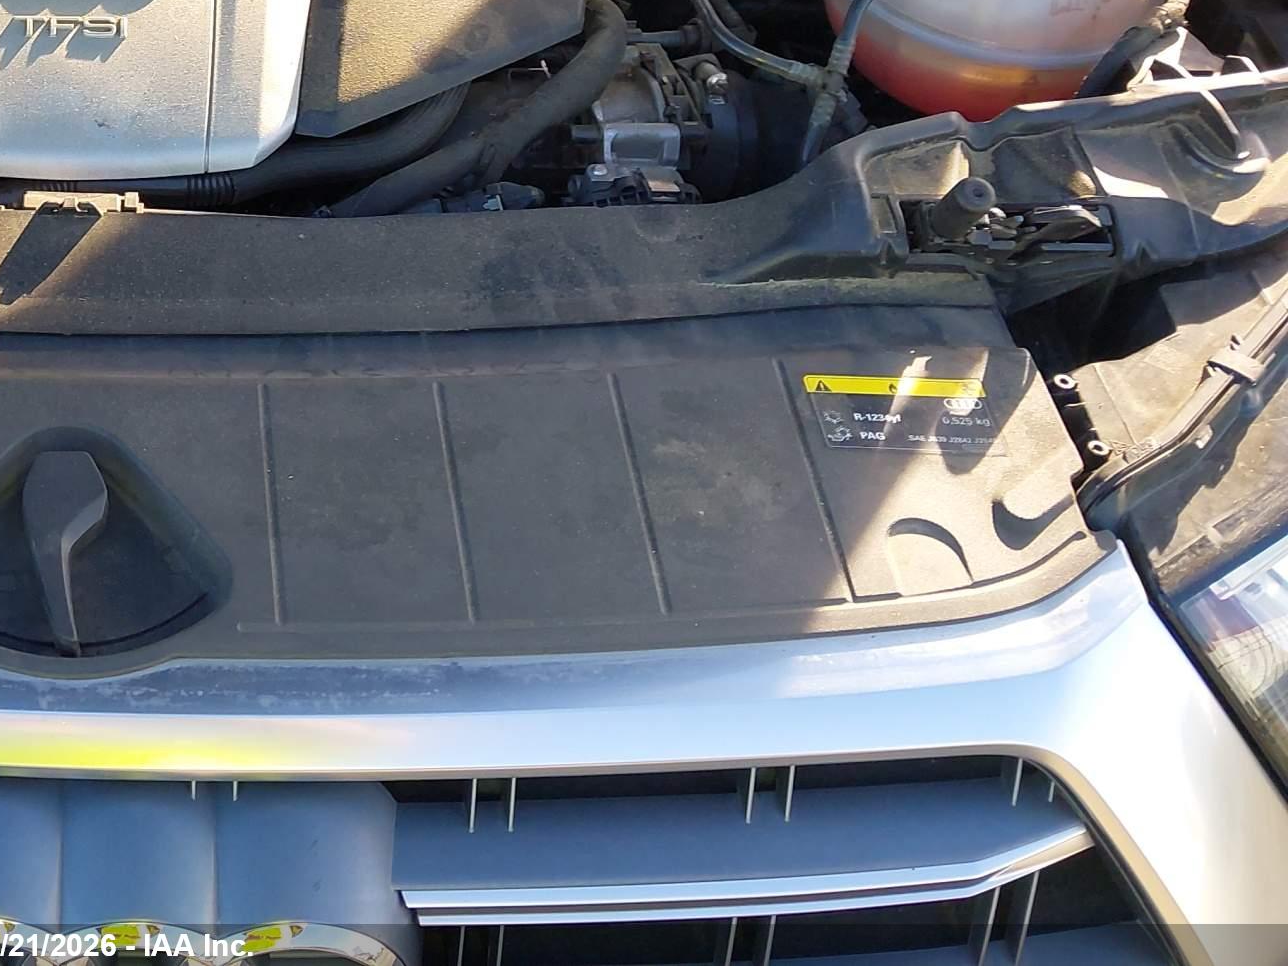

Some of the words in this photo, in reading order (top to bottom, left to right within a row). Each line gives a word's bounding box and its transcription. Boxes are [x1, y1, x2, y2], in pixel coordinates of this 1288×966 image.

[12, 15, 128, 39] TFSI
[975, 417, 990, 427] kg
[859, 431, 886, 441] PAG
